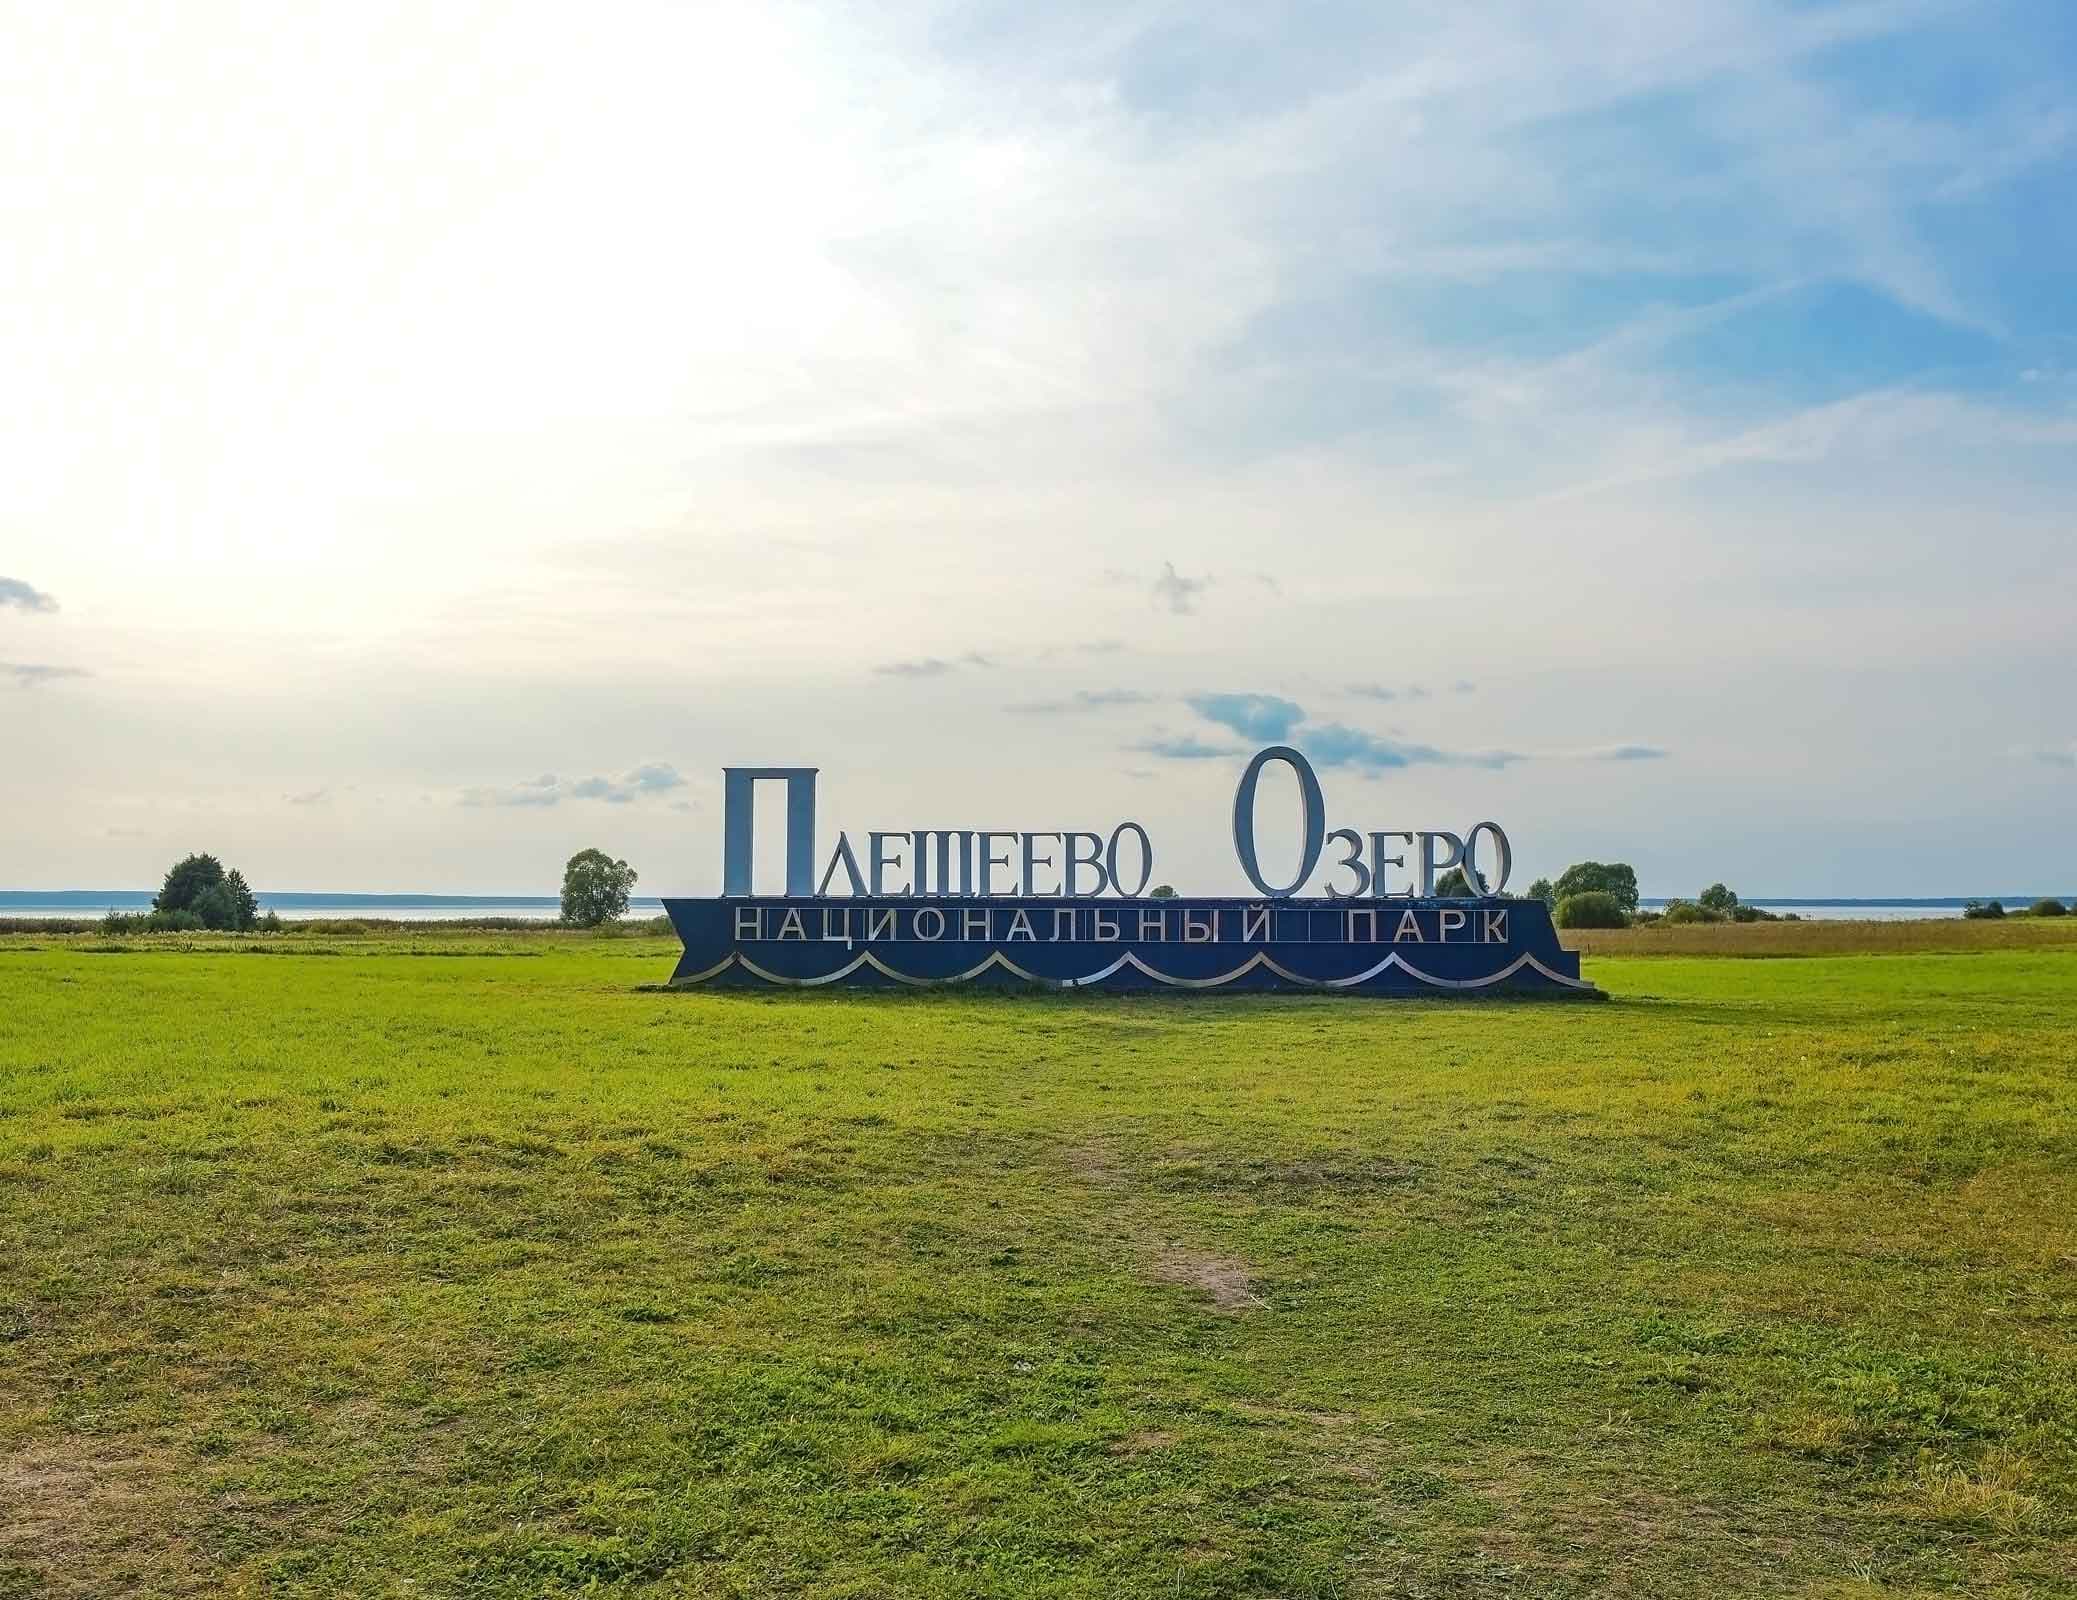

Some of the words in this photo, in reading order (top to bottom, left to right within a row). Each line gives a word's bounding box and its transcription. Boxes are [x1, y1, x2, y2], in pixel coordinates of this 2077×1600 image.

[1232, 746, 1512, 898] ОЗЕРО
[735, 905, 1272, 950] НАЦИОНАЛЬНЫЙ
[1347, 909, 1508, 944] ПАРК
